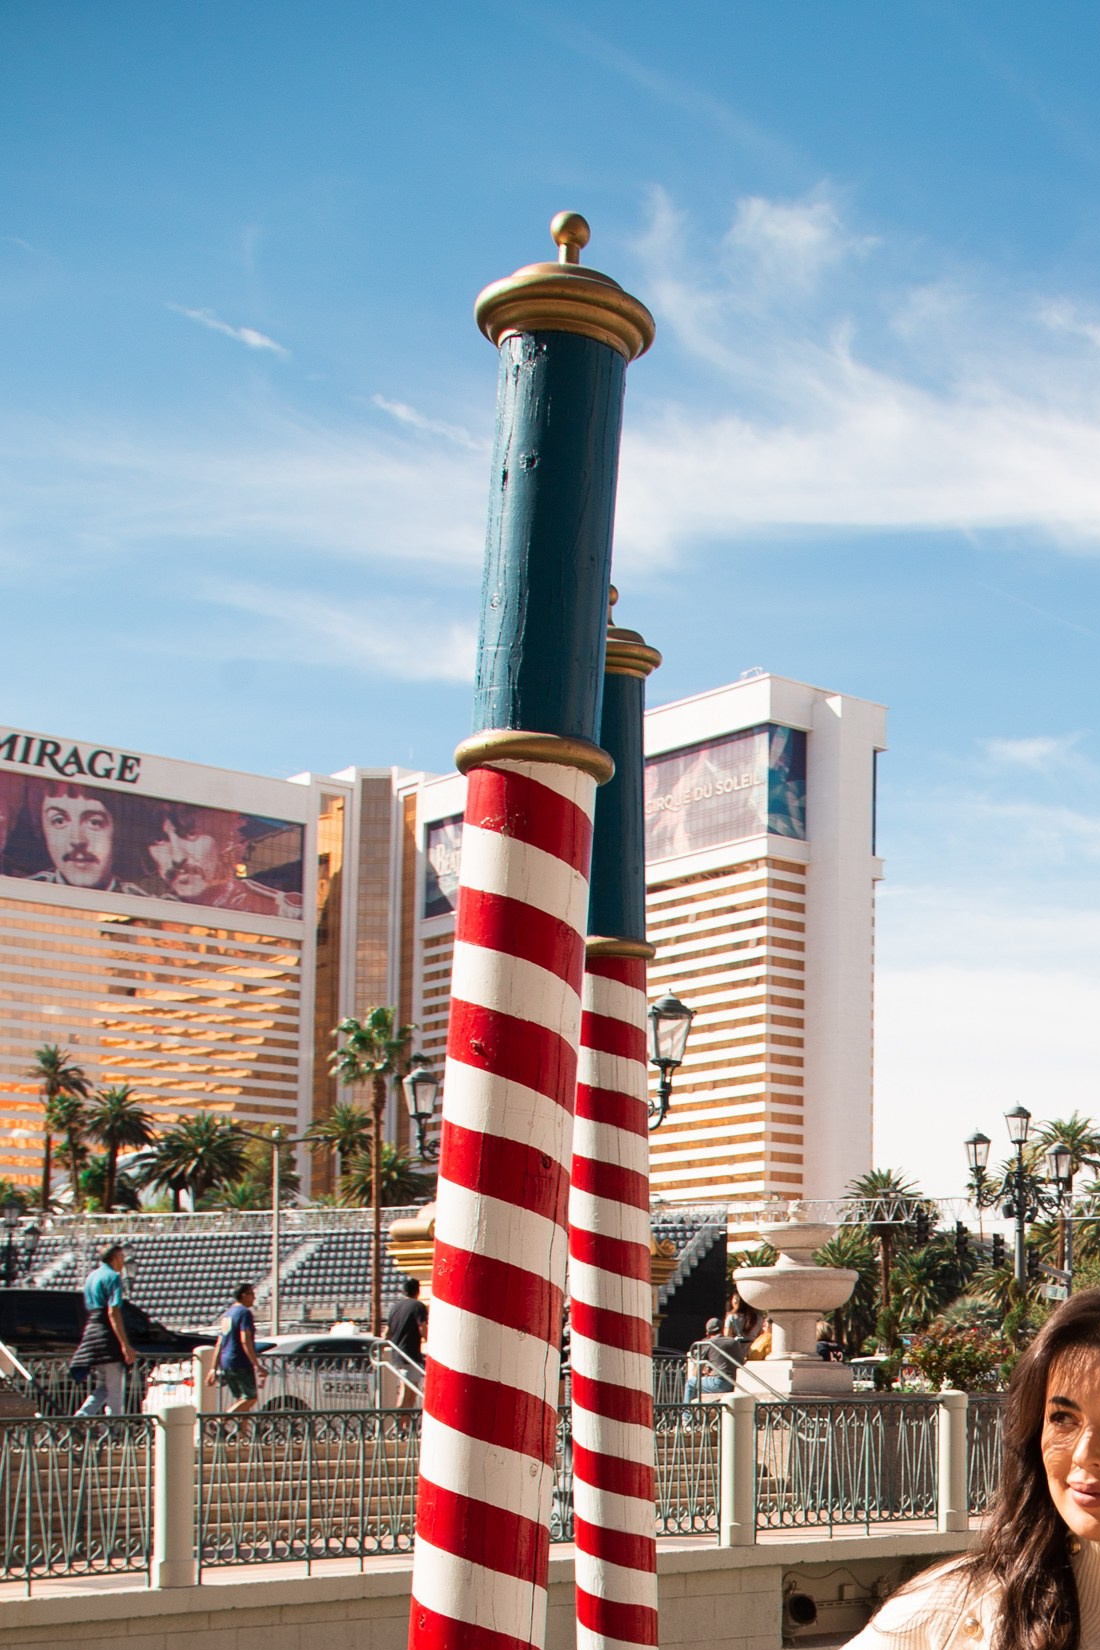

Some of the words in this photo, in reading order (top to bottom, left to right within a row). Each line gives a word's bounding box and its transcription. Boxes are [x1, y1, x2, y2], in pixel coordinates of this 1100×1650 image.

[645, 790, 692, 814] CIRQUE
[694, 784, 713, 801] DU
[715, 771, 763, 796] SOLEIL
